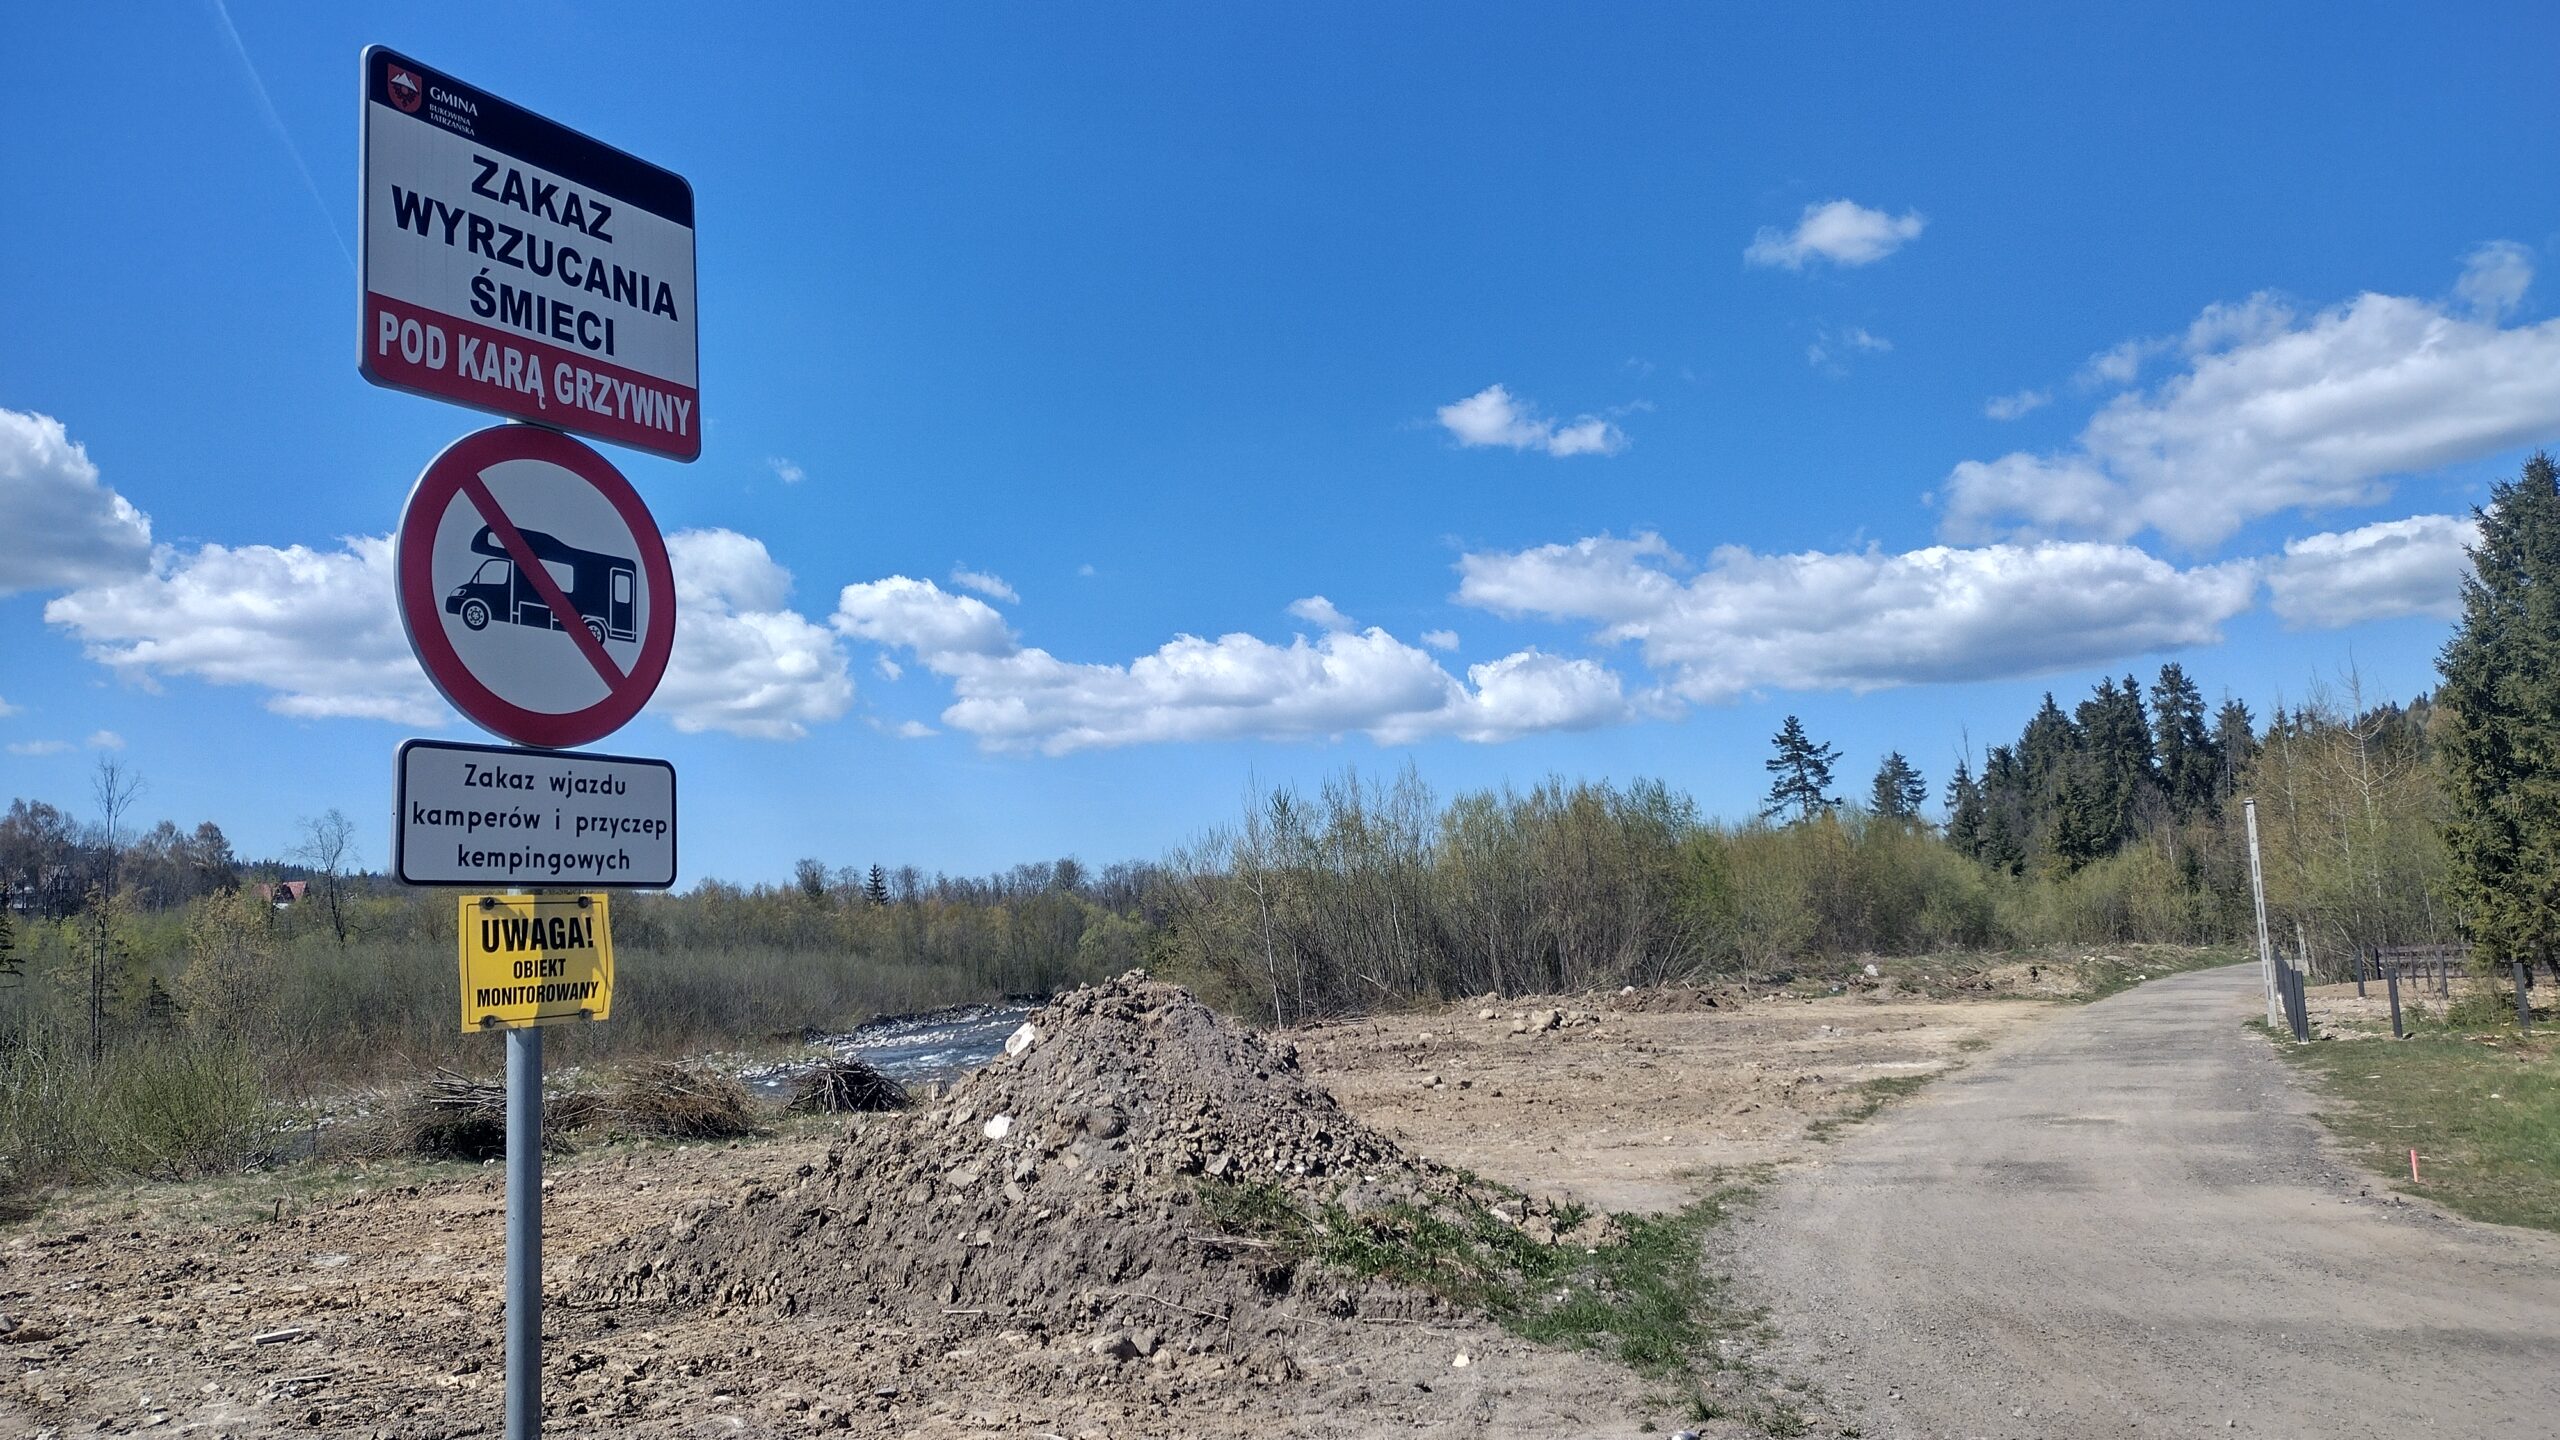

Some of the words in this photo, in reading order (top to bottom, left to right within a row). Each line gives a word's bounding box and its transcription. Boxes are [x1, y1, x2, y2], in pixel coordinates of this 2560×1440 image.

[429, 86, 478, 117] GMINA
[429, 103, 471, 127] BUKOWINA
[471, 154, 613, 244] ZAKAZ
[391, 184, 679, 322] WYRZUCANIA
[470, 267, 615, 357] ŚMIECI
[379, 311, 447, 370] POD
[458, 333, 546, 410] KARĄ
[554, 362, 692, 436] GRZYWNY
[464, 763, 535, 791] Zakaz
[549, 771, 626, 799] wjazdu
[412, 801, 541, 834] kamperów
[555, 808, 561, 831] i
[576, 814, 667, 840] przyczep
[457, 844, 630, 876] kempingowych
[481, 916, 594, 953] UWAGA!
[513, 958, 566, 979] OBIEKT
[476, 981, 599, 1008] MONITOROWANY
